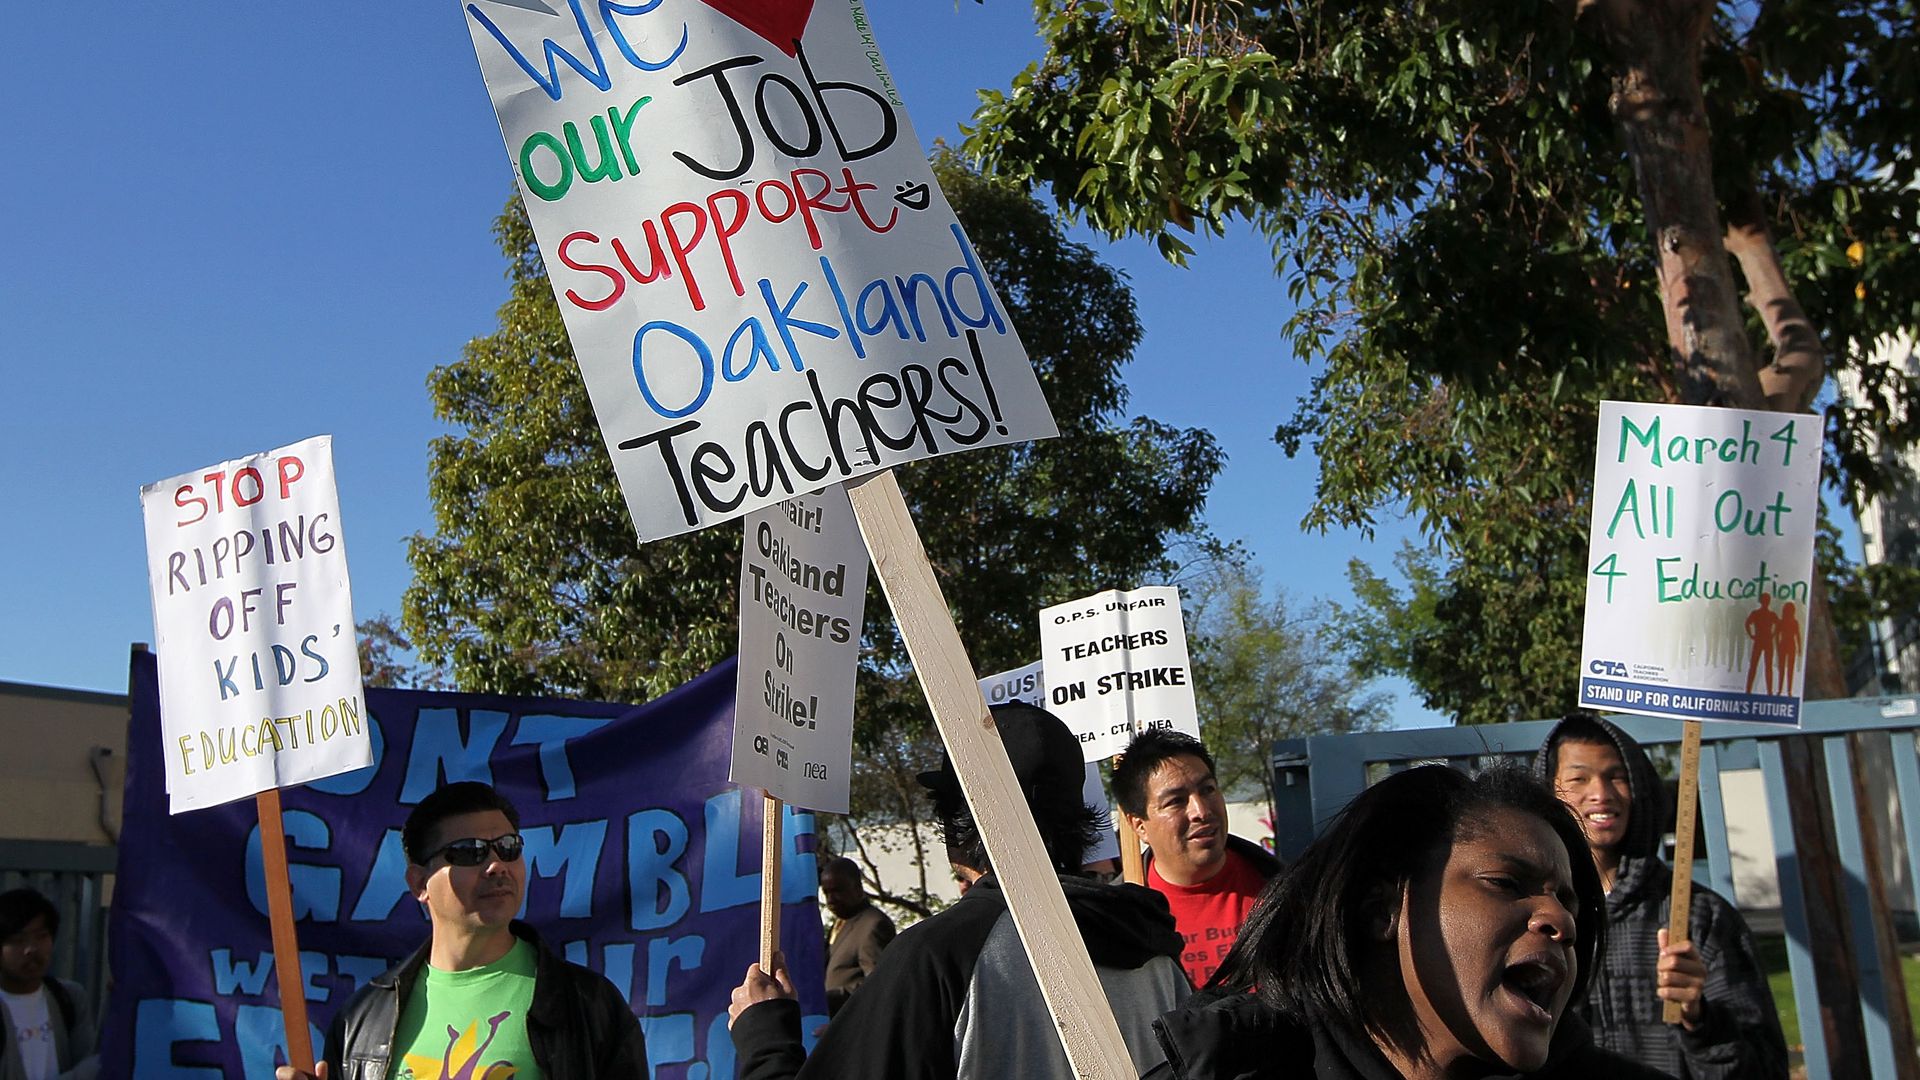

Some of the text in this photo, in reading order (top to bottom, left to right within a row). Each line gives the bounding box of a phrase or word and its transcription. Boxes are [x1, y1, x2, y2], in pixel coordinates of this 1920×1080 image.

[851, 7, 868, 33] Made
[519, 38, 898, 201] our Job
[632, 223, 1006, 419] Oakland
[1618, 415, 1798, 469] March 4
[174, 456, 305, 527] STOP
[1607, 478, 1792, 539] All Out
[168, 513, 335, 595] RIPPING
[757, 521, 847, 597] Oakland
[1592, 553, 1809, 605] 4 Education
[209, 582, 298, 640] OFF
[749, 563, 850, 644] Teachers
[1054, 598, 1166, 625] O.P.S. UNFAIR
[214, 624, 341, 700] KIDS'
[775, 631, 793, 675] On
[1061, 630, 1168, 661] TEACHERS
[1590, 660, 1629, 678] CTA
[764, 669, 818, 730] Strike!
[1052, 681, 1086, 705] ON
[1097, 667, 1186, 695] STRIKE
[1587, 684, 1795, 718] STAND UP FOR CALIFORNIA'S FUTURE
[178, 696, 361, 776] EDUCATION
[1111, 723, 1133, 735] CTA
[804, 762, 827, 780] nea
